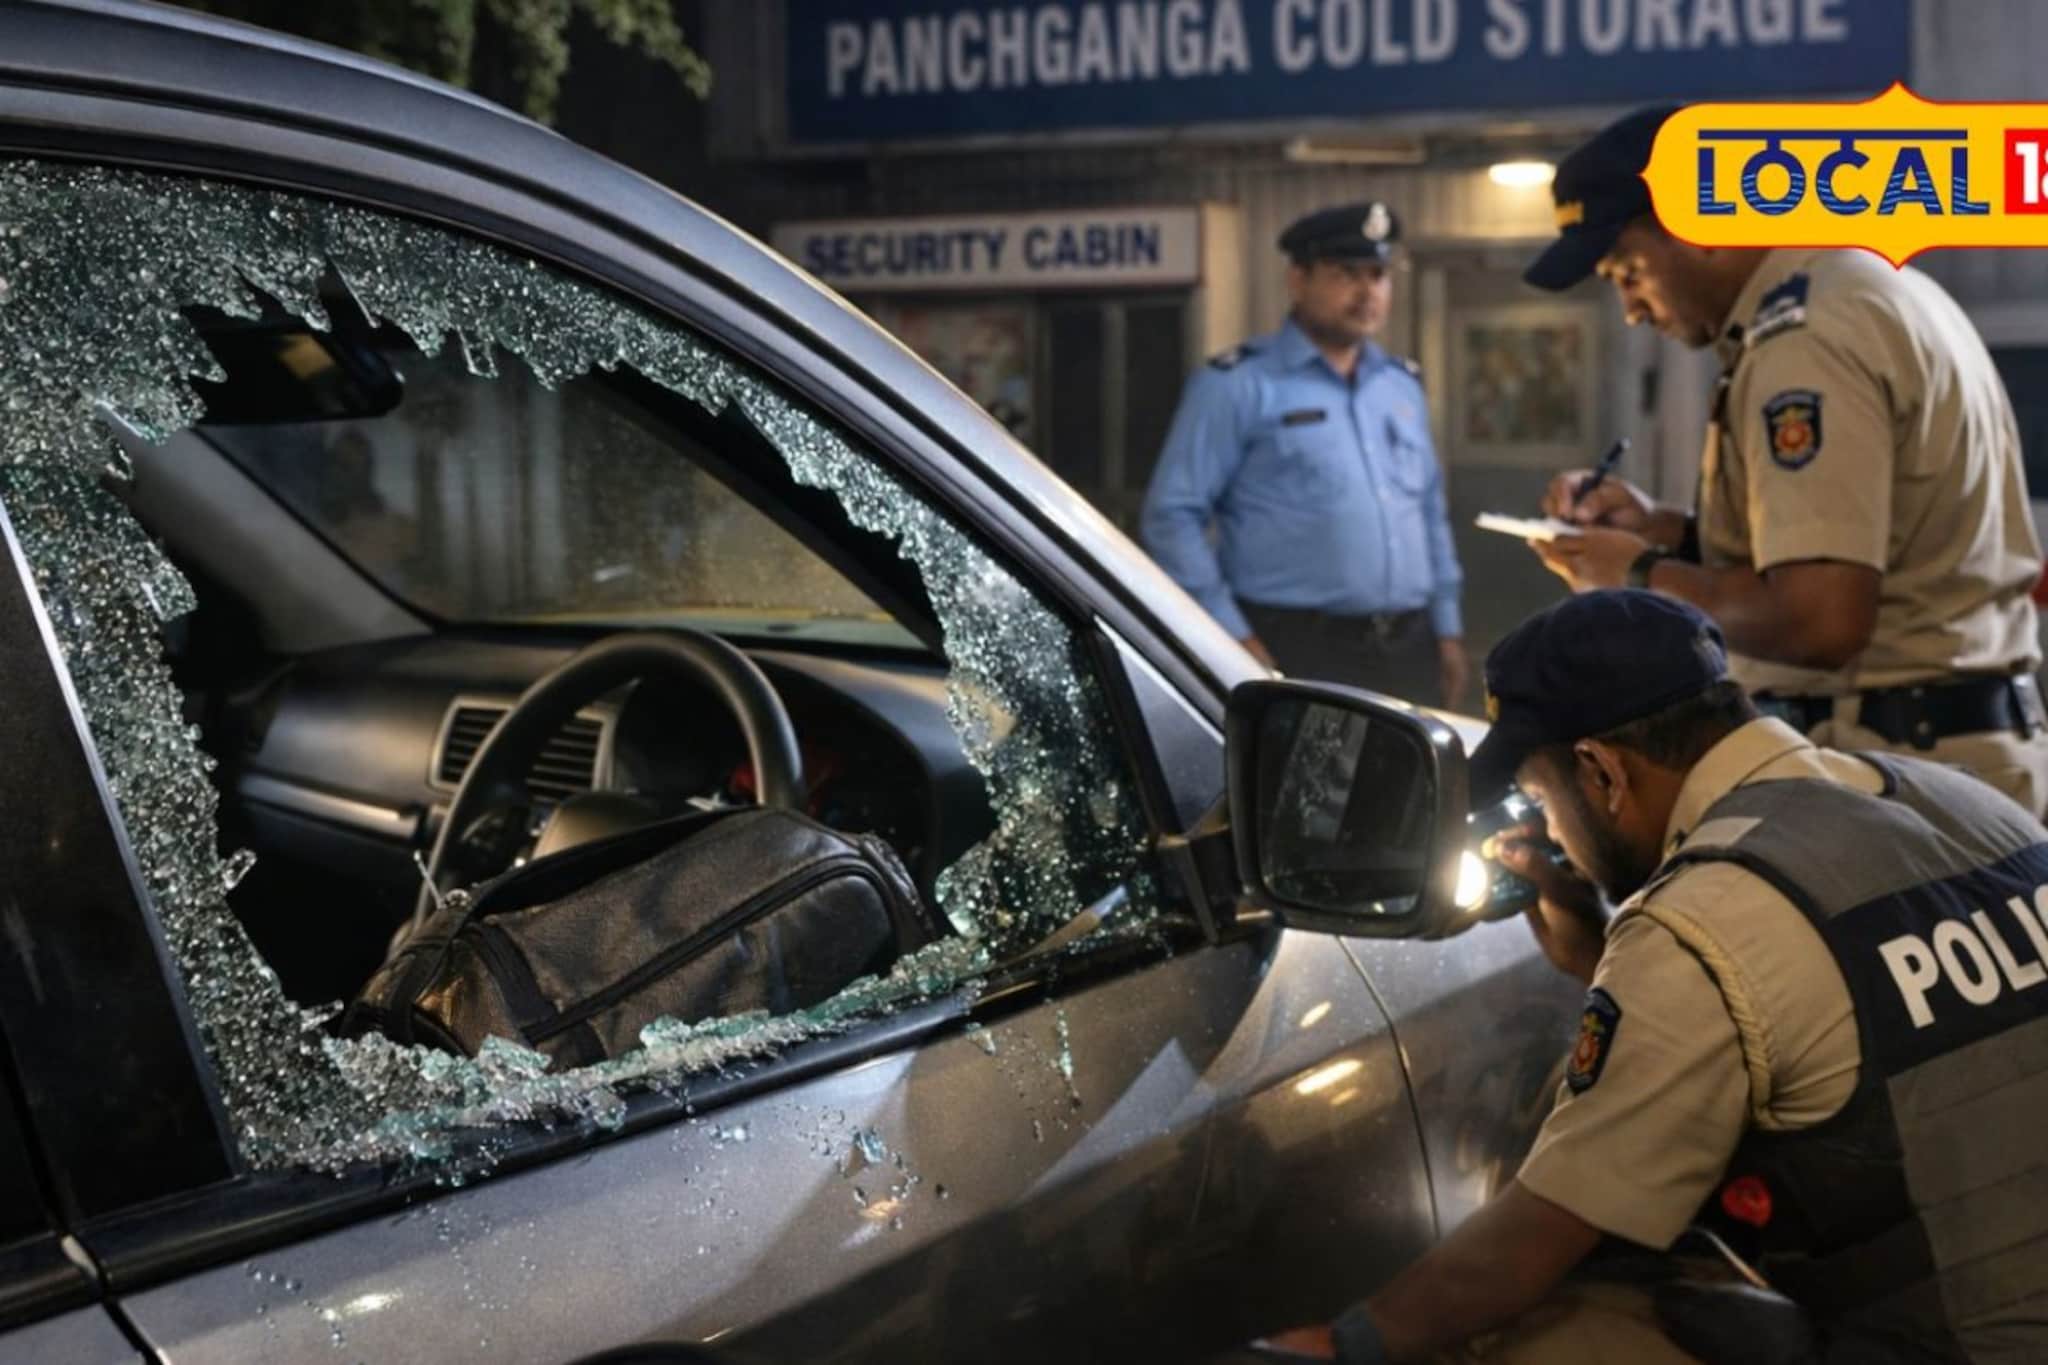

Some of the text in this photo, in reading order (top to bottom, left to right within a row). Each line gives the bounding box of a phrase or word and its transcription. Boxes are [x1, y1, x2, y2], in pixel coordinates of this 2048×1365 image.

[827, 0, 1250, 96] PANCHGANGA
[1273, 0, 1456, 71] COLD
[805, 224, 1160, 276] SECURITY CABIN
[1877, 884, 2048, 1029] POLI
